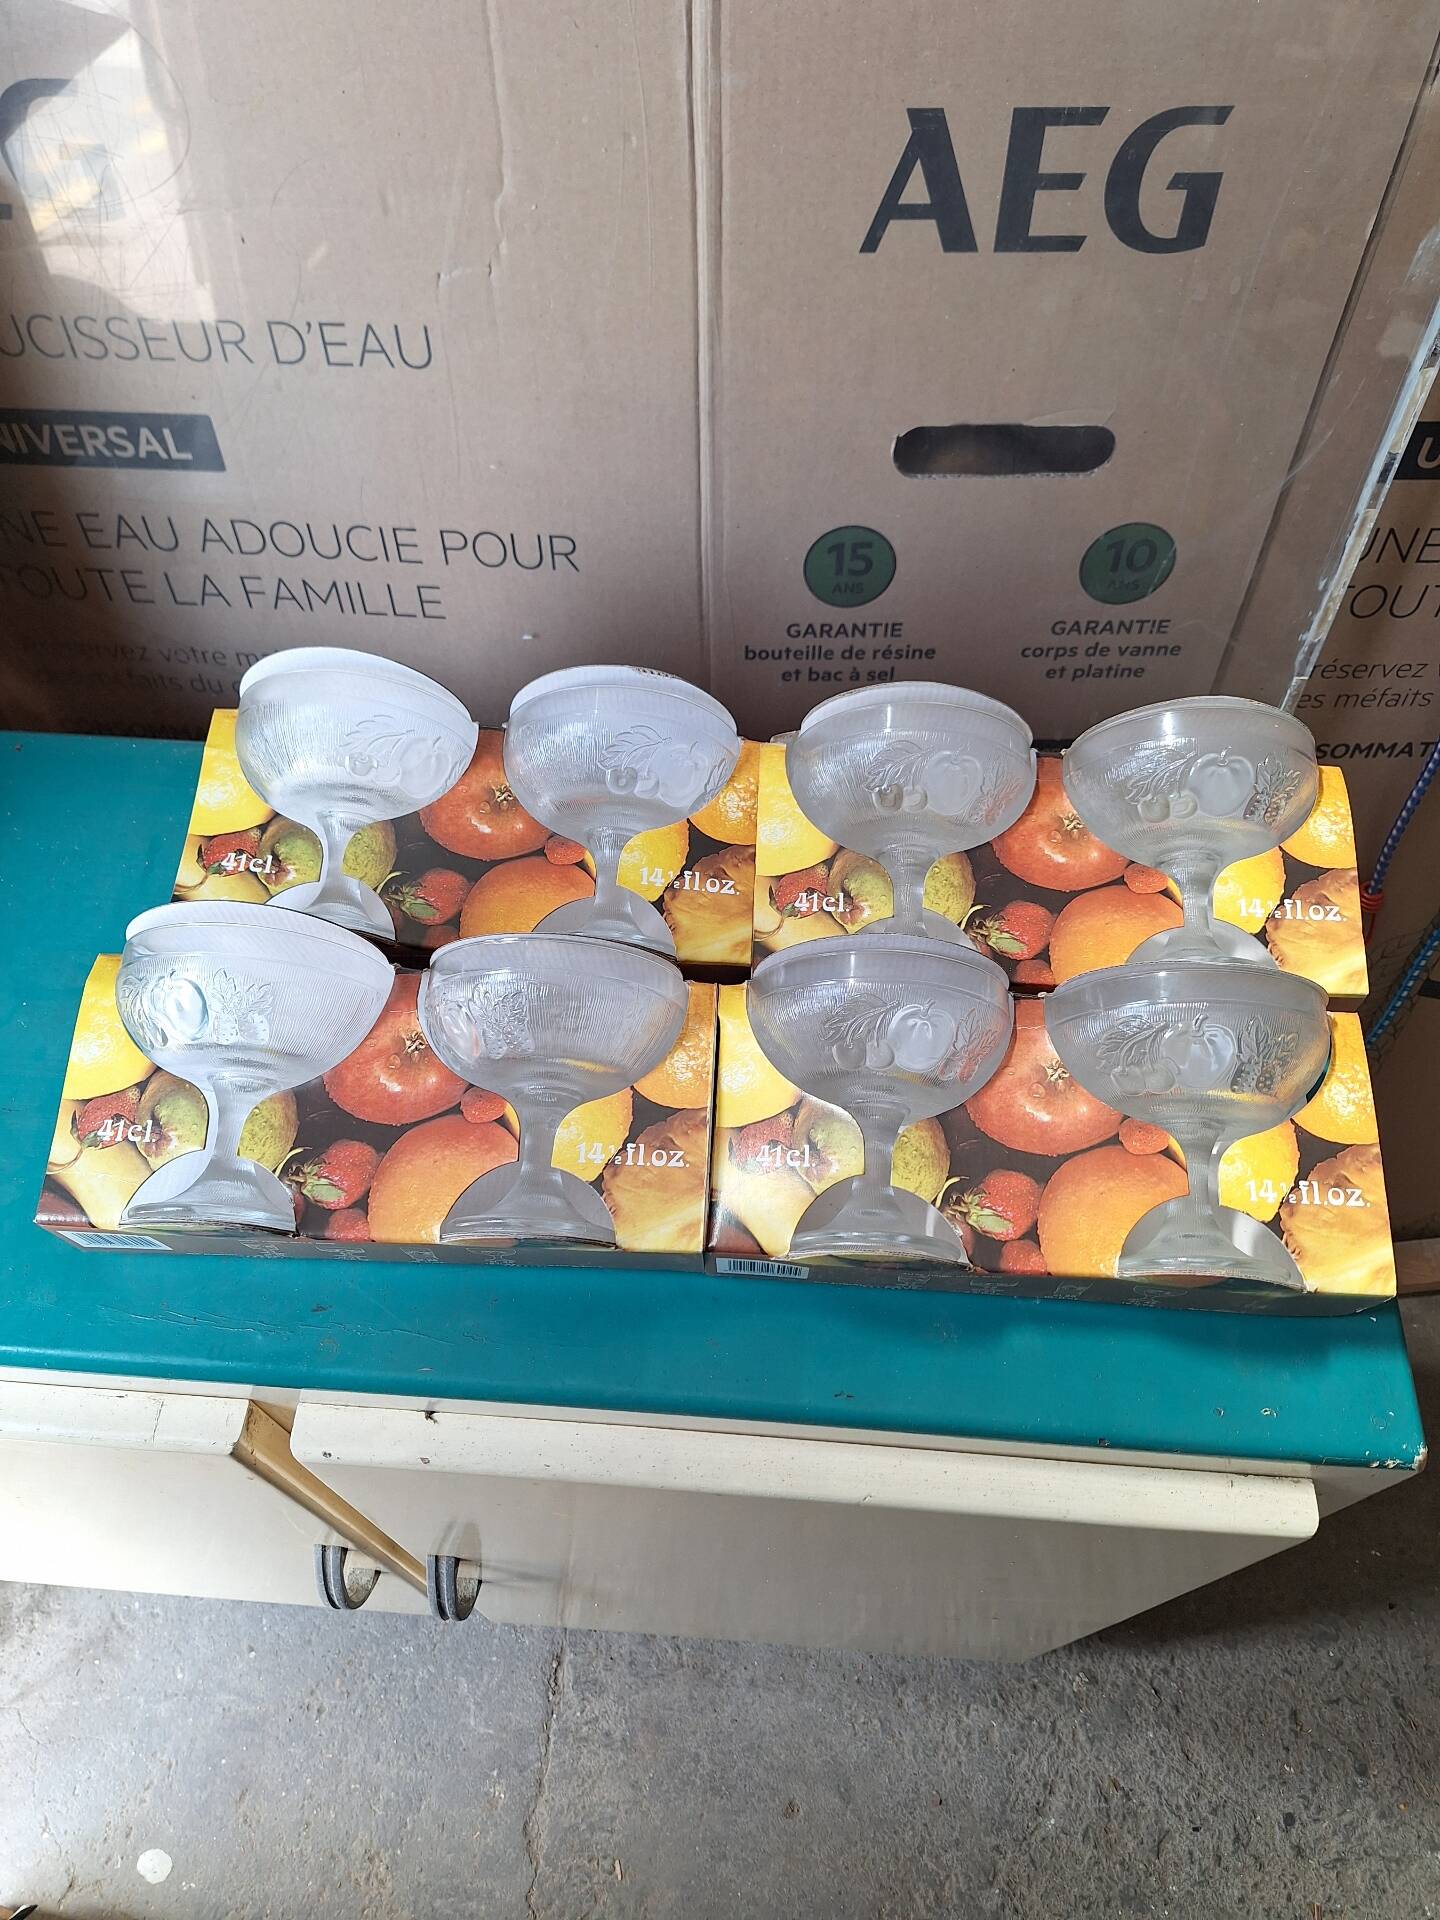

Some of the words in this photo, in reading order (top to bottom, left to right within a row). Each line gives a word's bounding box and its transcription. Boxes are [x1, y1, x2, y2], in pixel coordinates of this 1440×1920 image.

[859, 105, 1235, 254] AEG
[266, 320, 433, 370] D'EAU
[76, 513, 179, 551] EAU
[202, 518, 423, 564] ADOUCIE
[439, 530, 580, 573] POUR
[827, 541, 874, 577] 15
[1107, 538, 1158, 574] 10
[164, 571, 232, 607] LA
[240, 575, 446, 619] FAMILLE
[832, 582, 864, 594] ANS
[786, 622, 903, 639] GARANTIE
[1051, 619, 1171, 636] GARANTIE
[158, 646, 228, 668] votre
[744, 645, 834, 662] bouteille
[840, 645, 866, 662] de
[872, 643, 937, 661] résine
[1021, 645, 1078, 661] corps
[1084, 642, 1110, 657] de
[1118, 644, 1181, 657] vanne
[781, 667, 801, 682] et
[808, 666, 843, 682] bac
[849, 666, 861, 682] à
[867, 666, 895, 682] sel
[1045, 665, 1067, 680] et
[1071, 663, 1145, 682] platine
[1311, 658, 1429, 680] réservez
[190, 673, 223, 694] du
[1333, 686, 1434, 709] méfaits
[220, 852, 276, 873] 41cl.
[794, 892, 850, 912] 41cl.
[97, 1119, 156, 1142] 41cl.
[756, 1144, 816, 1168] 41cl.
